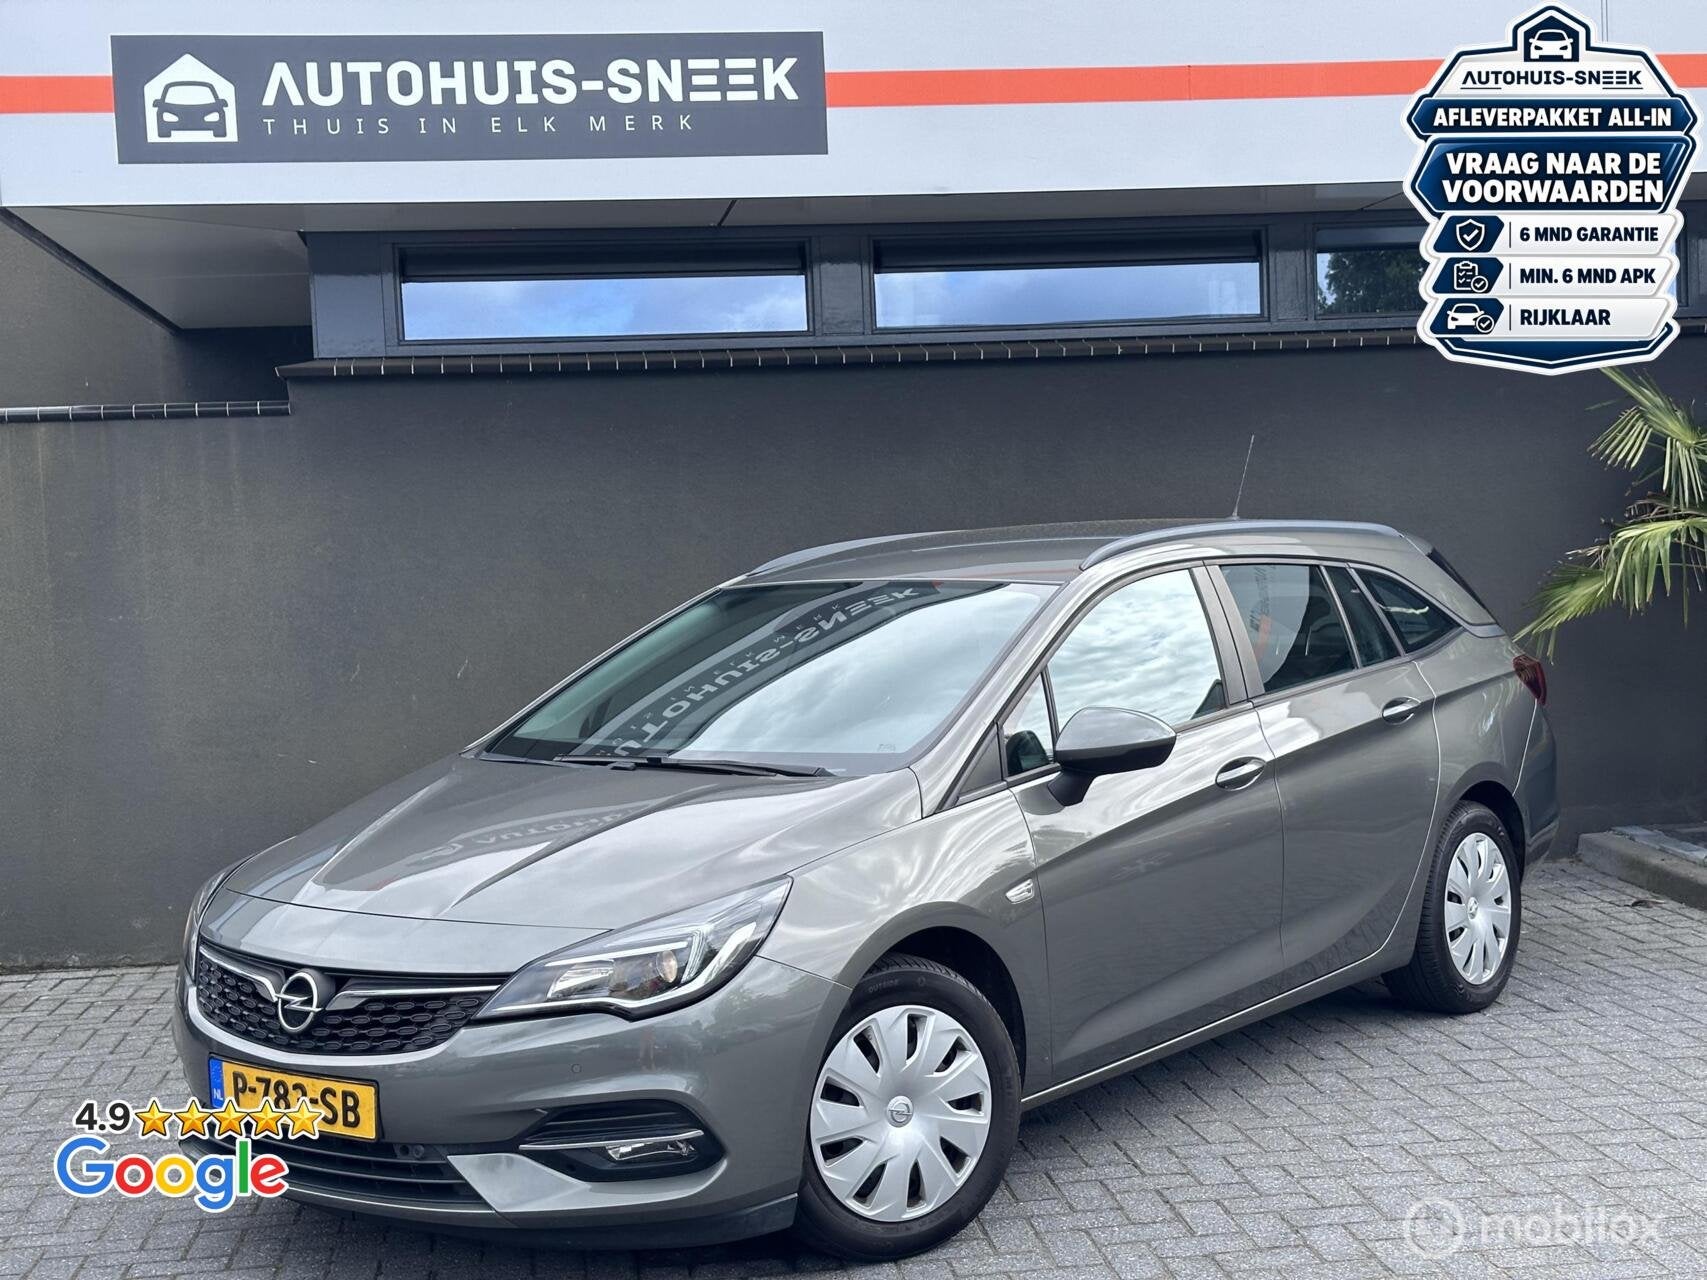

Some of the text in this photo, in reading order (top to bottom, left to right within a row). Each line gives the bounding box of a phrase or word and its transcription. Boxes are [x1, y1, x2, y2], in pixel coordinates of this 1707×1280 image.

[261, 57, 799, 107] AUTOHUIS-SNEEK
[263, 114, 692, 135] THUIS IN ELK MERK
[213, 1087, 224, 1100] NL
